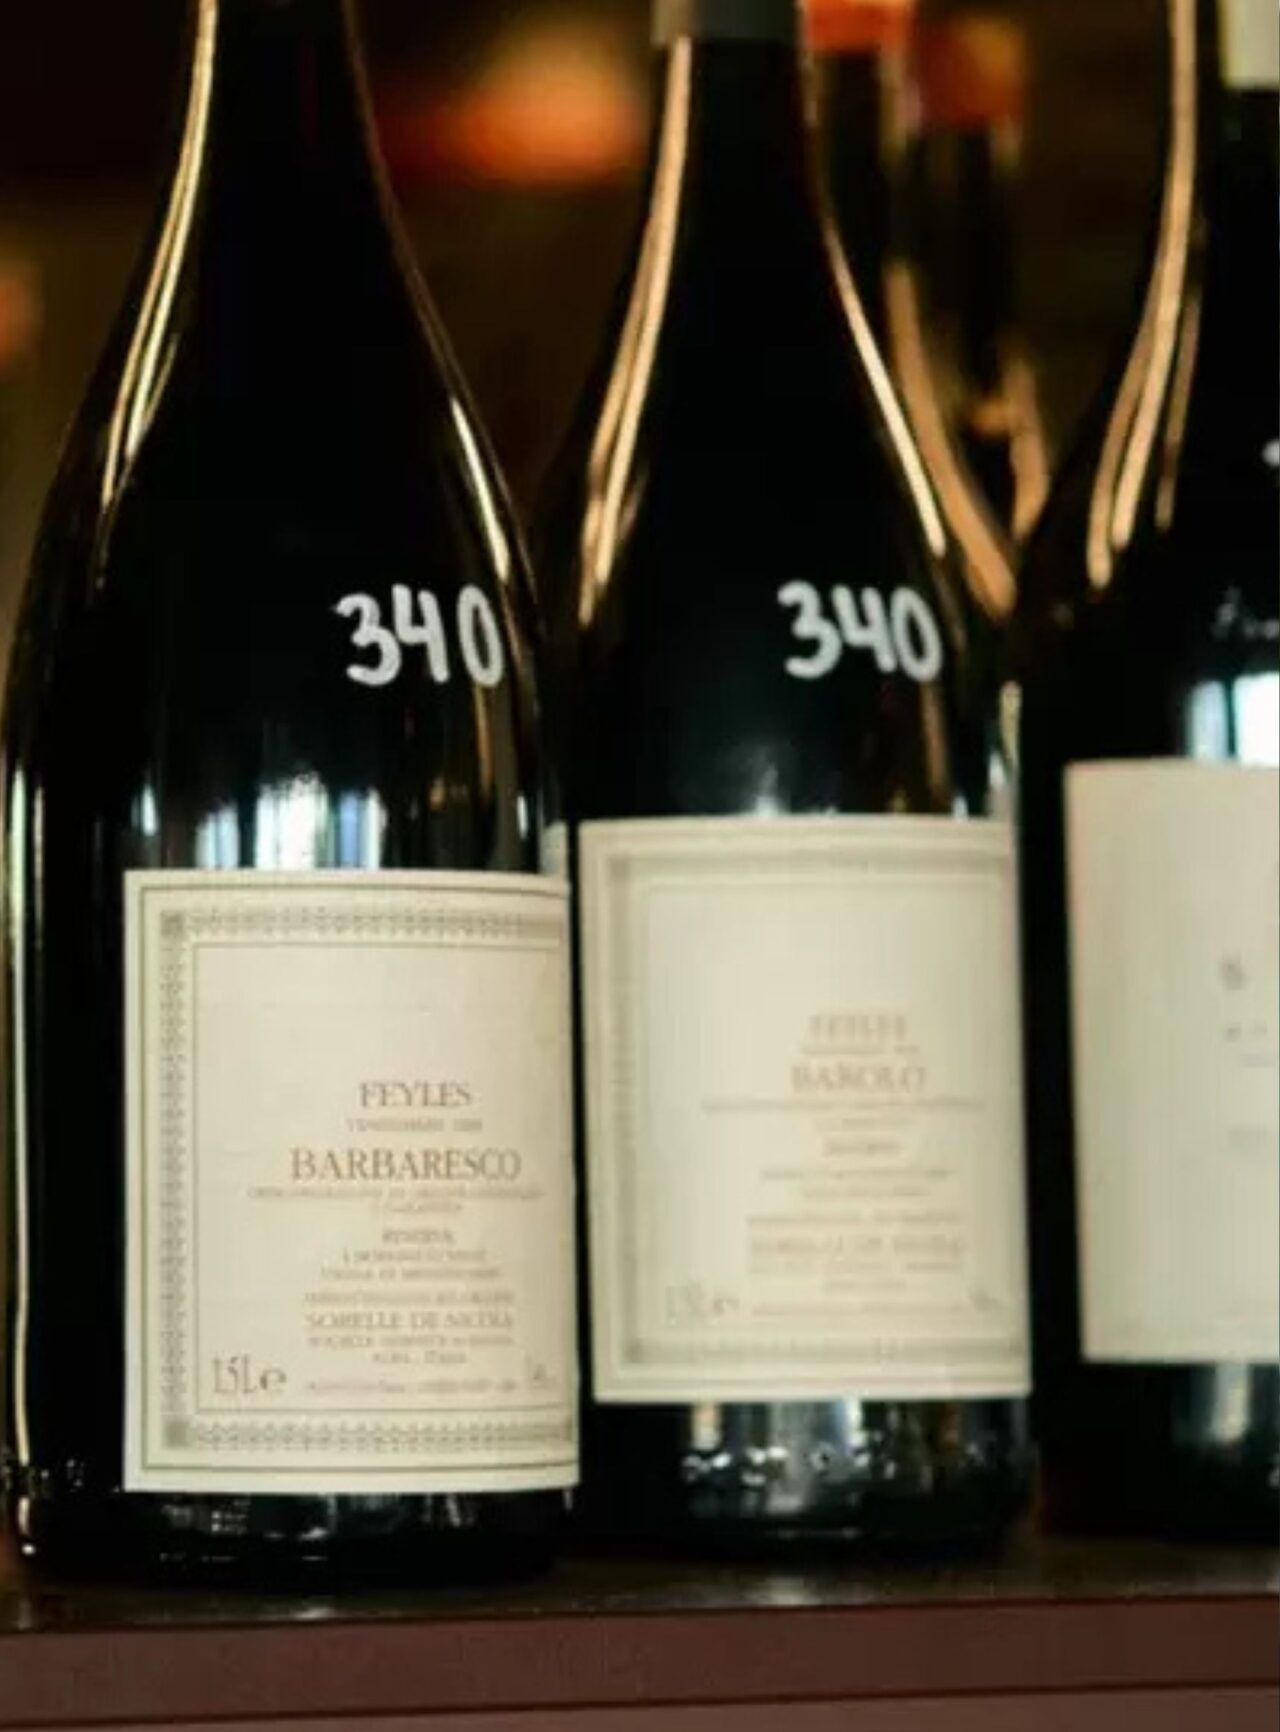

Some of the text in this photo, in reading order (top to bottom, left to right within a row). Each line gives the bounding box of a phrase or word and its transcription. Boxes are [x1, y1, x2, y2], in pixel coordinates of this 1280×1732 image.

[334, 584, 504, 687] 340
[778, 581, 942, 682] 340
[359, 1081, 471, 1107] FEYLES
[290, 1148, 522, 1181] BARBARESCO
